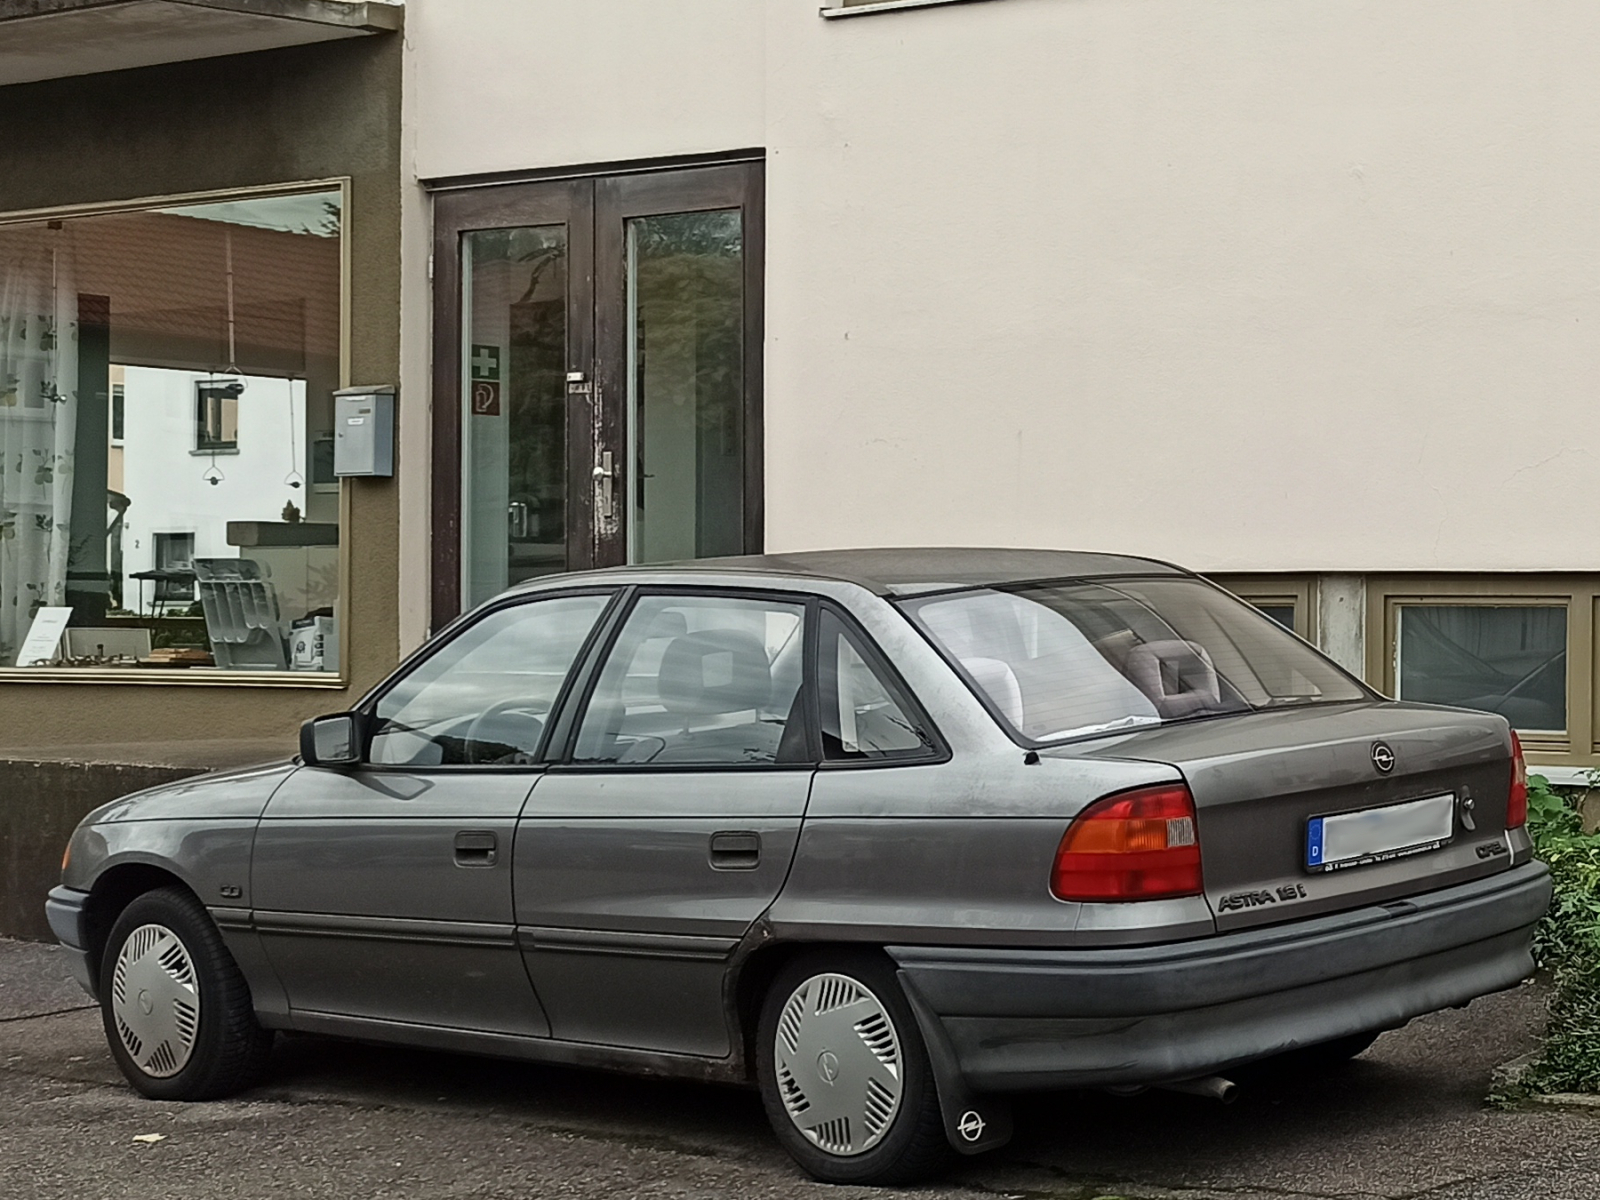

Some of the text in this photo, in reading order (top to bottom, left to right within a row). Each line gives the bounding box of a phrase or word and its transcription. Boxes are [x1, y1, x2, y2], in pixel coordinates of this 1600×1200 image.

[1312, 846, 1319, 856] D
[1475, 841, 1507, 859] OPEL
[1218, 889, 1276, 913] ASTRA
